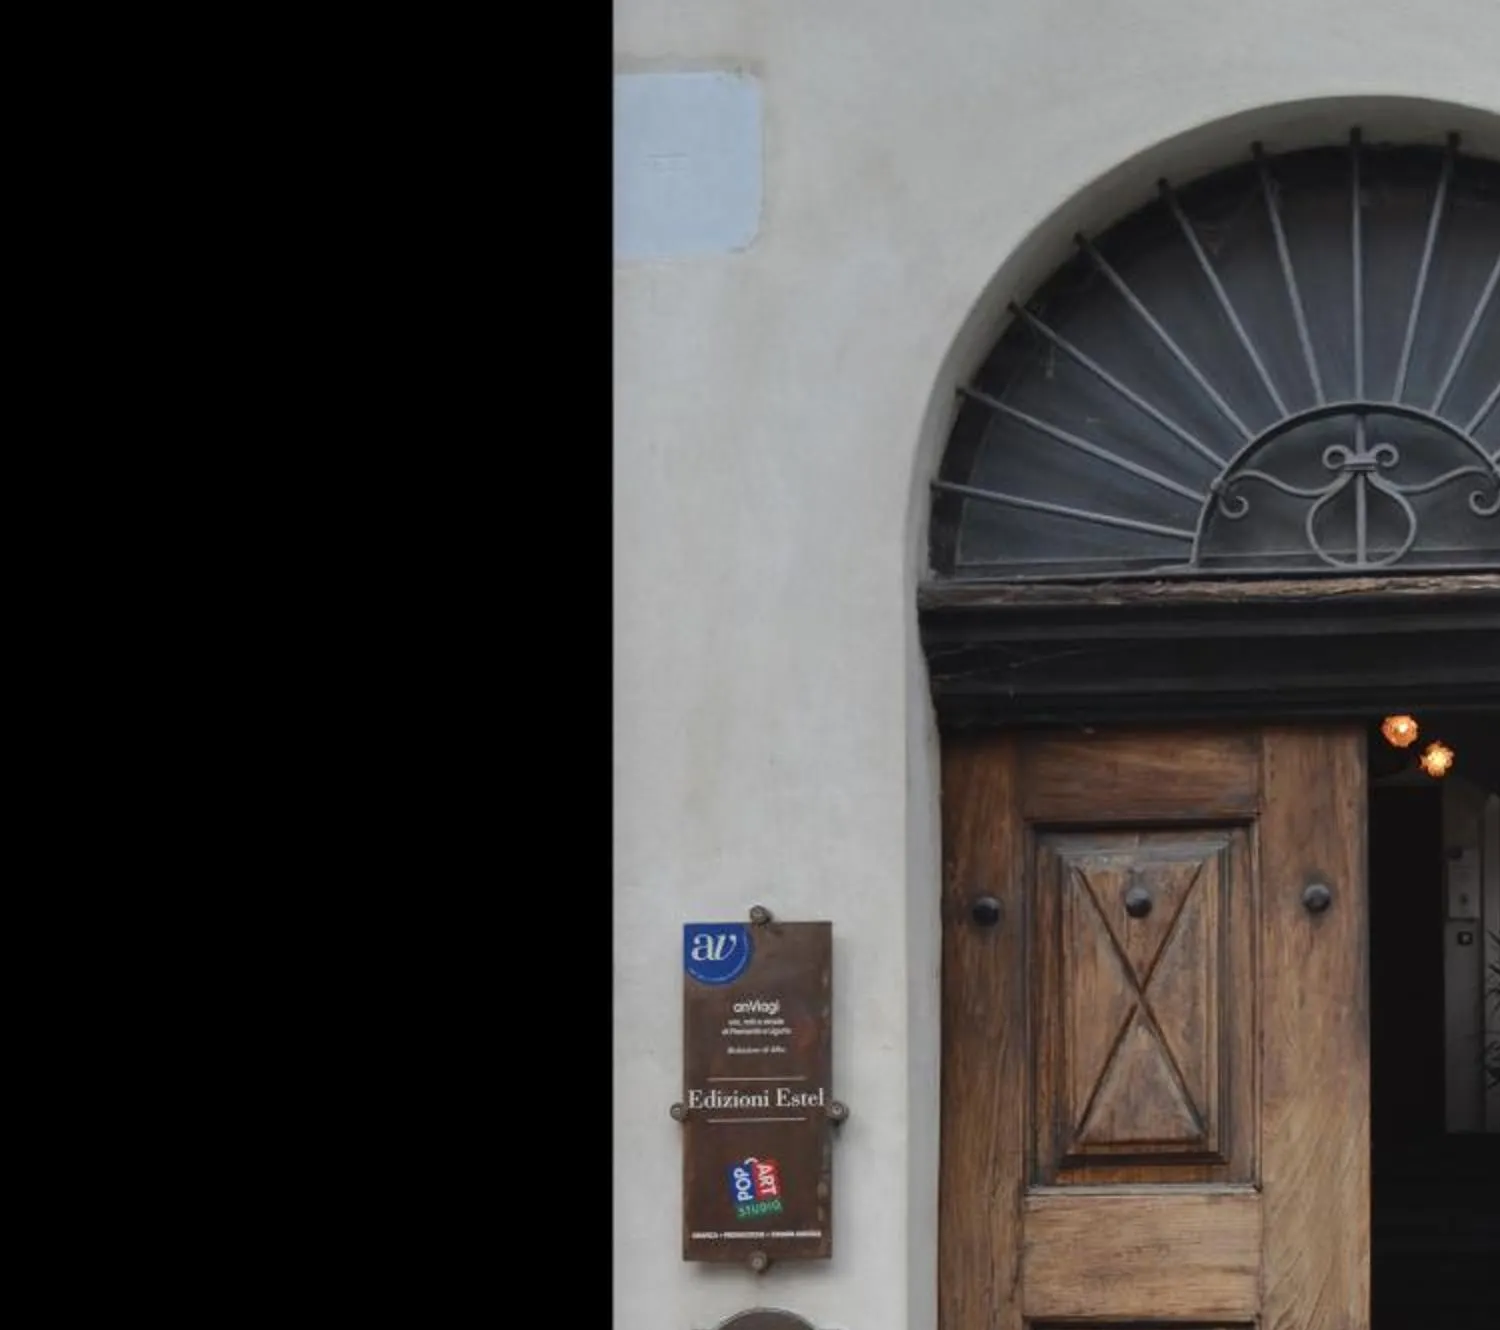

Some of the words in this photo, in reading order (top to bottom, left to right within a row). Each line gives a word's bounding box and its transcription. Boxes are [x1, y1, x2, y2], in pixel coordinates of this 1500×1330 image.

[691, 933, 738, 961] av
[687, 1088, 770, 1109] Edizioni
[775, 1086, 825, 1107] Estel
[733, 1167, 754, 1202] POP
[757, 1163, 778, 1196] ART
